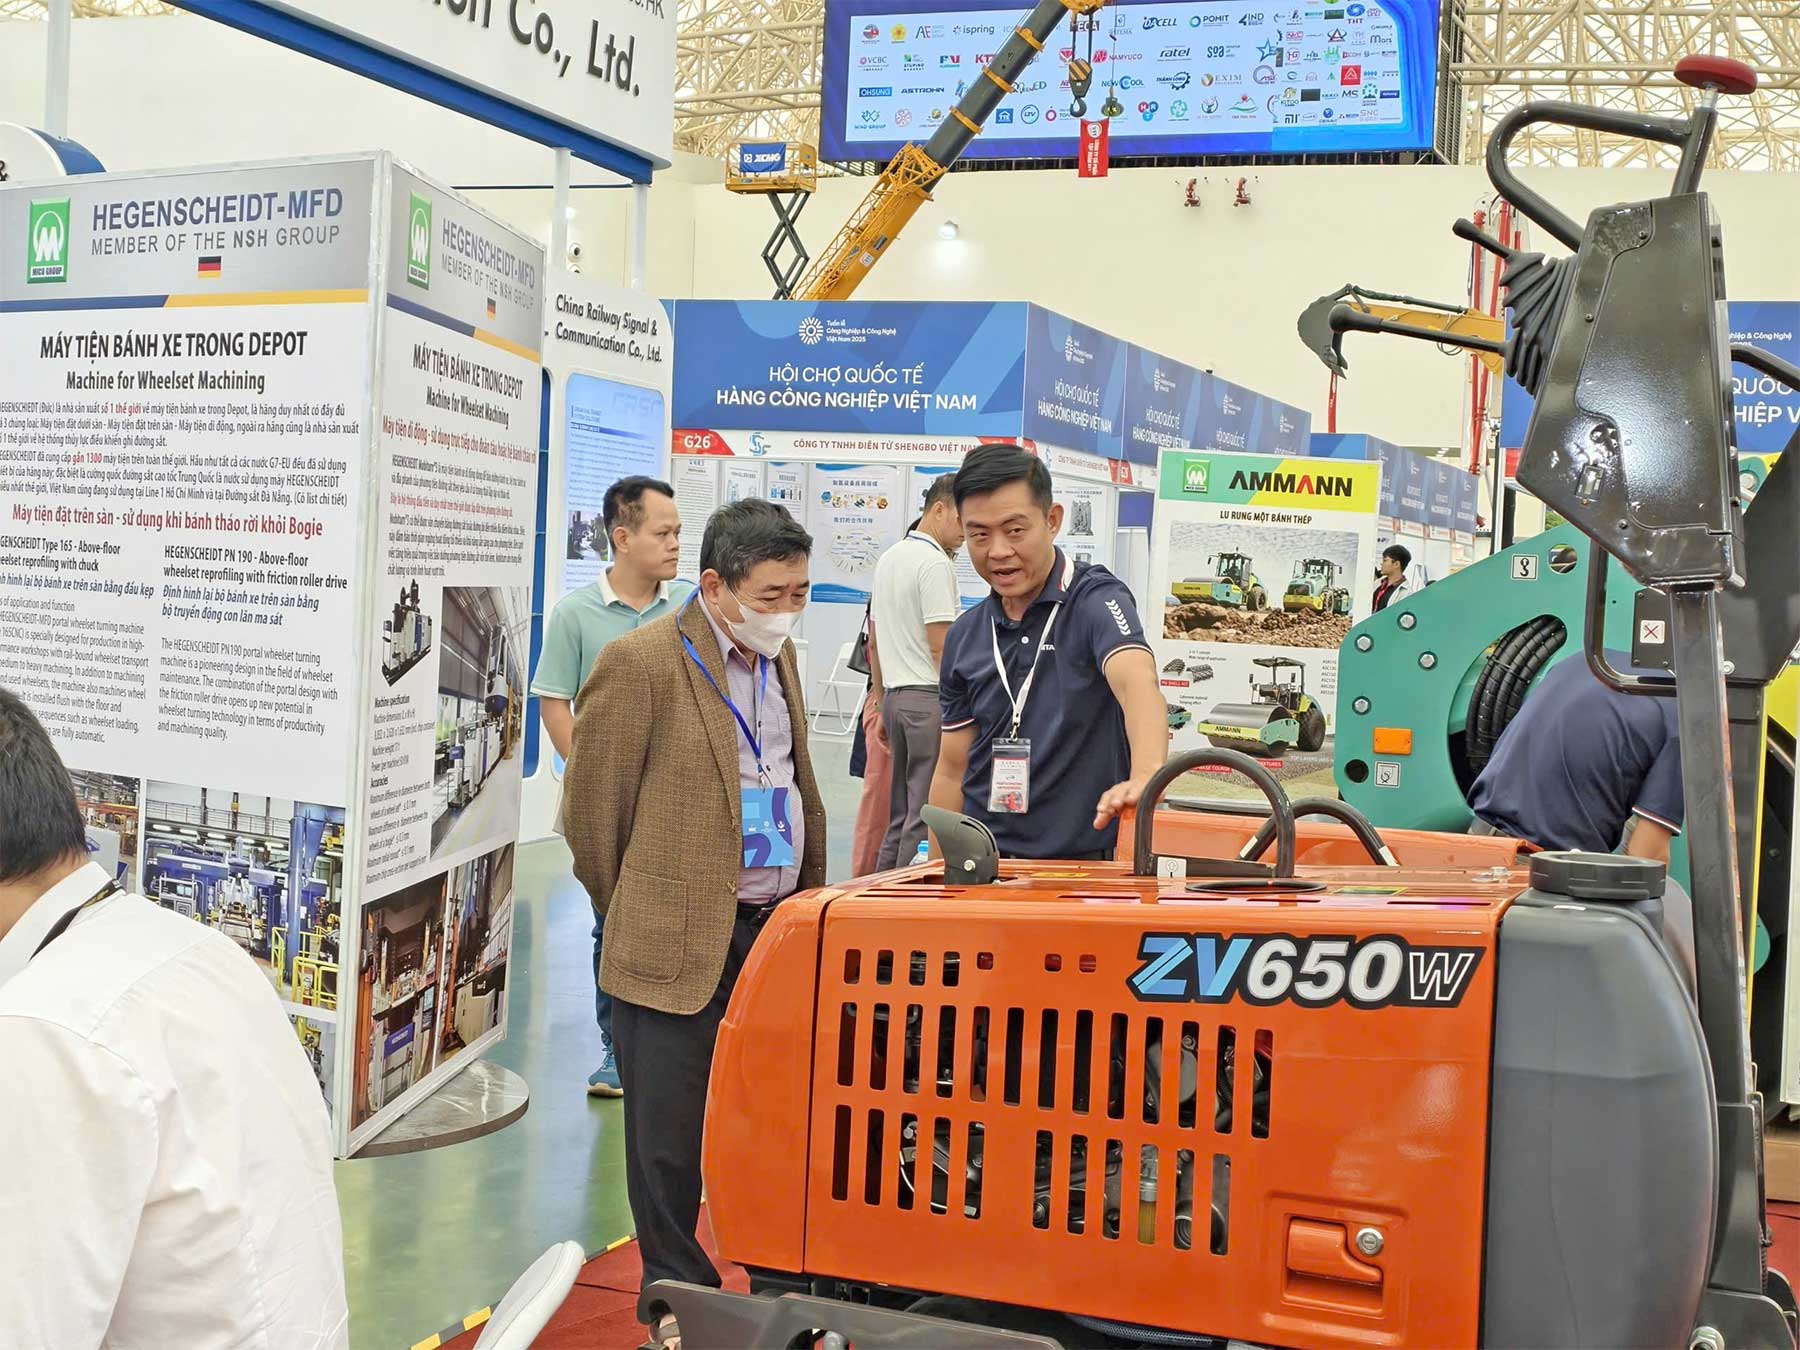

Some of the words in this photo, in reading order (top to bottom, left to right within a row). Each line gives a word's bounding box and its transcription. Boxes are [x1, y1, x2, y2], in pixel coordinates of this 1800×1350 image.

[963, 25, 994, 35] ispring
[509, 0, 571, 78] Co.,
[587, 19, 639, 97] Ltd.
[93, 188, 343, 231] HEGENSCHEIDT-MFD
[92, 235, 158, 255] MEMBER
[165, 233, 187, 251] OF
[194, 231, 225, 249] THE
[233, 229, 267, 248] NSH
[276, 225, 340, 247] GROUP
[442, 218, 535, 289] HEGENSCHEIDT-MFD
[442, 253, 472, 283] MEMBER
[475, 269, 483, 287] OF
[485, 273, 498, 295] THE
[556, 294, 584, 317] China
[587, 302, 621, 330] Railway
[623, 311, 650, 334] Signal
[651, 320, 657, 336] &
[40, 331, 71, 359] MÁY
[76, 330, 109, 364] TIỆN
[113, 329, 157, 358] BÁNH
[162, 333, 182, 357] XE
[185, 332, 244, 357] TRONG
[249, 331, 307, 356] DEPOT
[556, 321, 626, 354] Communication
[628, 340, 645, 361] Co.,
[647, 344, 662, 362] Ltd.
[1753, 332, 1773, 340] Công
[1773, 333, 1792, 341] Nghệ
[66, 370, 114, 390] Machine
[117, 370, 135, 390] for
[137, 370, 194, 390] Wheelset
[198, 370, 265, 394] Machining
[413, 342, 432, 371] MÁY
[432, 348, 449, 382] TIỆN
[450, 352, 471, 384] BÁNH
[471, 364, 480, 387] XE
[481, 366, 503, 394] TRONG
[503, 374, 523, 400] DEPOT
[769, 363, 798, 386] HỘI
[802, 367, 841, 387] CHỢ
[845, 361, 898, 384] QUỐC
[902, 362, 925, 385] TẾ
[426, 386, 450, 410] Machine
[451, 392, 460, 413] for
[460, 396, 484, 419] Wheelset
[485, 400, 509, 430] Machining
[716, 385, 766, 406] HÀNG
[769, 387, 822, 408] CÔNG
[825, 389, 890, 412] NGHIỆP
[894, 390, 932, 413] VIỆT
[935, 395, 977, 410] NAM
[1038, 397, 1054, 418] HÀNG
[1055, 402, 1070, 423] CÔNG
[1070, 409, 1089, 430] NGHIỆP
[1734, 401, 1783, 428] HIỆP
[684, 435, 711, 448] G26
[793, 439, 817, 449] CÔNG
[819, 440, 830, 449] TY
[831, 440, 857, 449] TNHH
[895, 442, 938, 452] SHENGBO
[939, 441, 959, 454] VIỆT
[286, 474, 339, 488] HEGENSCHEIDT
[1228, 470, 1353, 497] AMMANN
[12, 503, 32, 526] Máy
[34, 505, 53, 526] tiện
[55, 505, 71, 527] đặt
[74, 507, 94, 525] trên
[96, 507, 114, 526] sàn
[121, 508, 135, 526] sử
[136, 509, 163, 532] dụng
[165, 510, 182, 529] khi
[184, 511, 212, 531] bánh
[215, 512, 241, 532] tháo
[244, 514, 258, 533] rời
[261, 515, 286, 534] khỏi
[289, 516, 323, 540] Bogie
[1220, 510, 1229, 519] LU
[1231, 511, 1252, 521] RUNG
[1253, 511, 1270, 523] MỘT
[1271, 513, 1292, 523] BÁNH
[1293, 514, 1312, 525] THÉP
[42, 538, 58, 556] Type
[60, 540, 73, 552] 165
[78, 540, 121, 555] Above-floor
[164, 545, 223, 562] HEGENSCHEIDT
[224, 549, 235, 562] PN
[238, 550, 253, 563] 190
[259, 552, 308, 567] Above-floor
[22, 555, 59, 572] reprofiling
[61, 557, 77, 570] with
[78, 557, 99, 572] chuck
[163, 565, 200, 579] wheelset
[201, 567, 244, 584] reprofiling
[246, 570, 265, 583] with
[267, 571, 298, 586] friction
[300, 573, 324, 587] roller
[325, 574, 348, 589] drive
[243, 646, 263, 659] portal
[264, 648, 294, 661] wheelset
[295, 650, 320, 666] turning
[1214, 725, 1241, 734] AMMANN
[1132, 937, 1475, 1002] ZV650W
